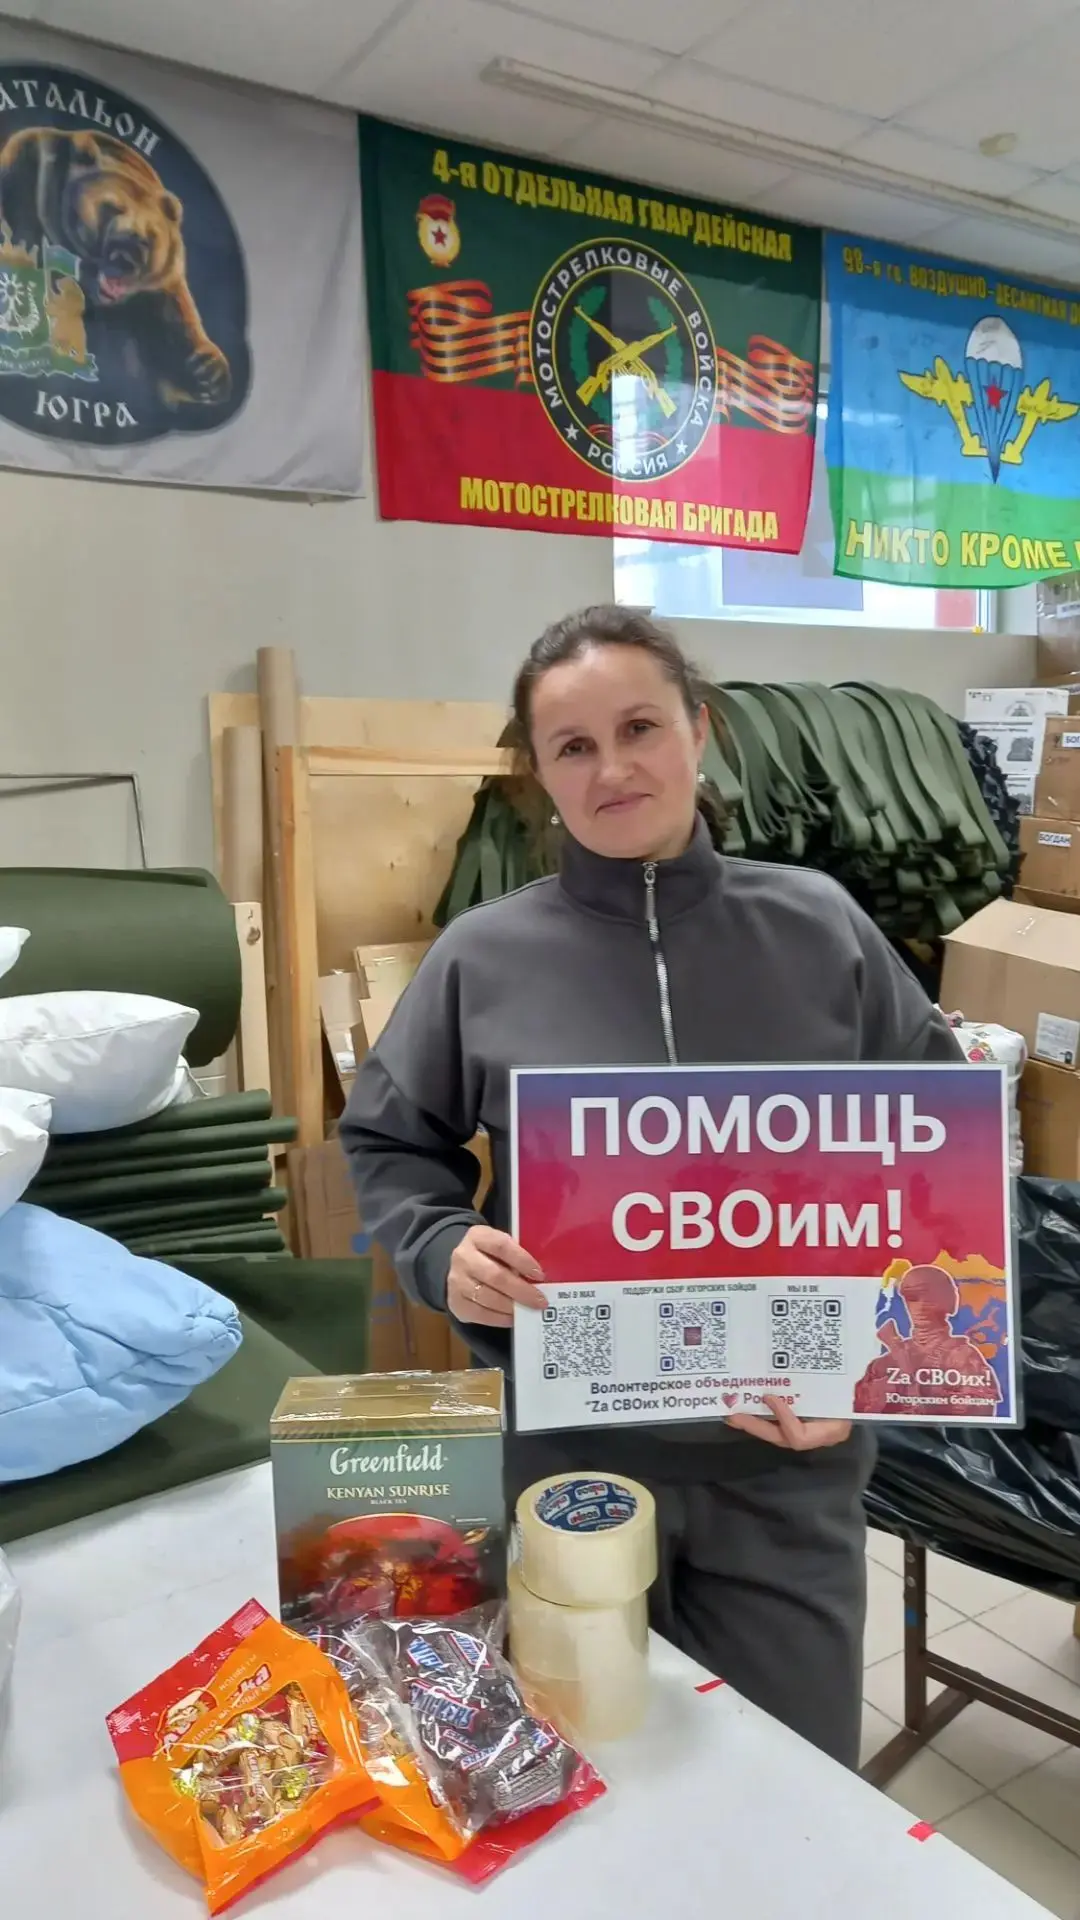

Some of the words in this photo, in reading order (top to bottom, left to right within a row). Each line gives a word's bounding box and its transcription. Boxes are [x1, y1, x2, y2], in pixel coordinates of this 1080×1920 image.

[0, 79, 160, 157] АТАЛЬОН
[482, 161, 634, 225] ОТДЕЛЬНАЯ
[638, 198, 793, 264] ГВАРДЕЙСКАЯ
[536, 246, 683, 409] МОТОСТРЕЛКОВЫЕ
[687, 311, 716, 427] ВОЙСКА
[33, 389, 140, 428] ЮГРА
[587, 442, 669, 476] РОССИЯ
[459, 476, 678, 530] МОТОСТРЕЛКОВАЯ
[682, 502, 779, 542] БРИГАДА
[844, 518, 950, 567] НИКТО
[960, 530, 1073, 570] КРОМЕ
[1065, 735, 1080, 745] БОГ
[1039, 833, 1072, 845] БОГДАН
[569, 1093, 947, 1166] ПОМОЩЬ
[611, 1189, 904, 1252] СВОим!
[590, 1380, 692, 1396] Волонтерское
[695, 1375, 792, 1390] объединение
[915, 1368, 992, 1387] СВОих!
[612, 1398, 659, 1411] СВОих
[662, 1394, 718, 1411] Югорск
[885, 1392, 948, 1406] Югорским
[329, 1443, 444, 1475] Greenfield
[327, 1485, 385, 1500] KENYAN
[388, 1484, 450, 1498] SUNRISE
